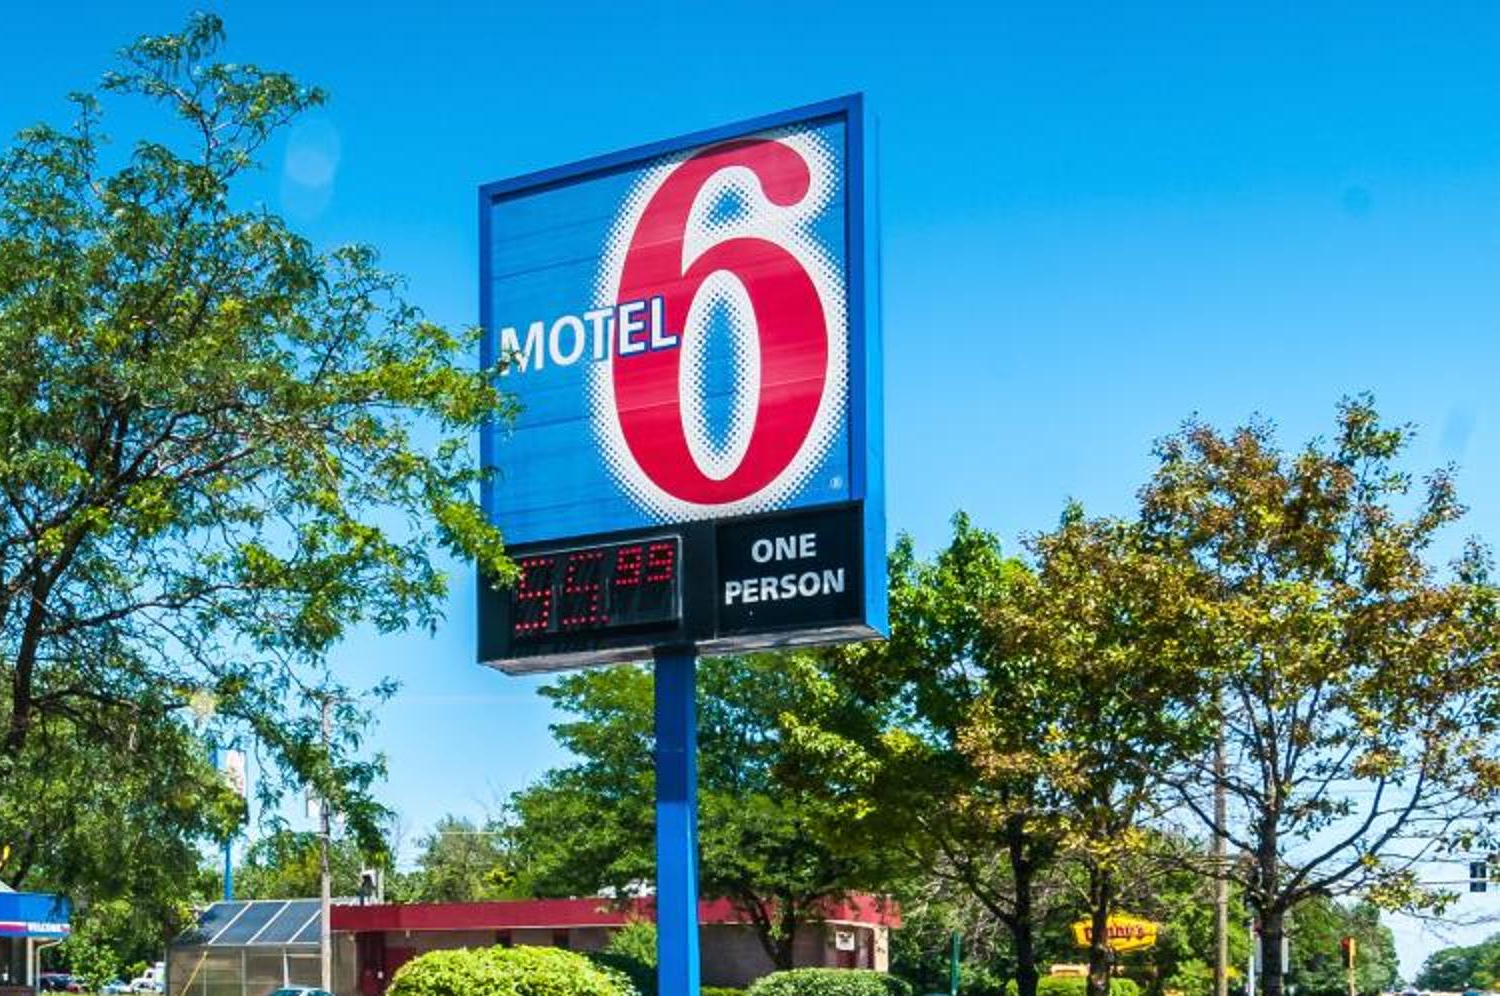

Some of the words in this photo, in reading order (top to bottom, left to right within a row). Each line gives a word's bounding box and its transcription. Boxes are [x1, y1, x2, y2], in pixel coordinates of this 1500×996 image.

[500, 296, 677, 375] MOTEL
[613, 138, 829, 505] 6
[751, 532, 817, 563] ONE
[725, 568, 846, 605] PERSON
